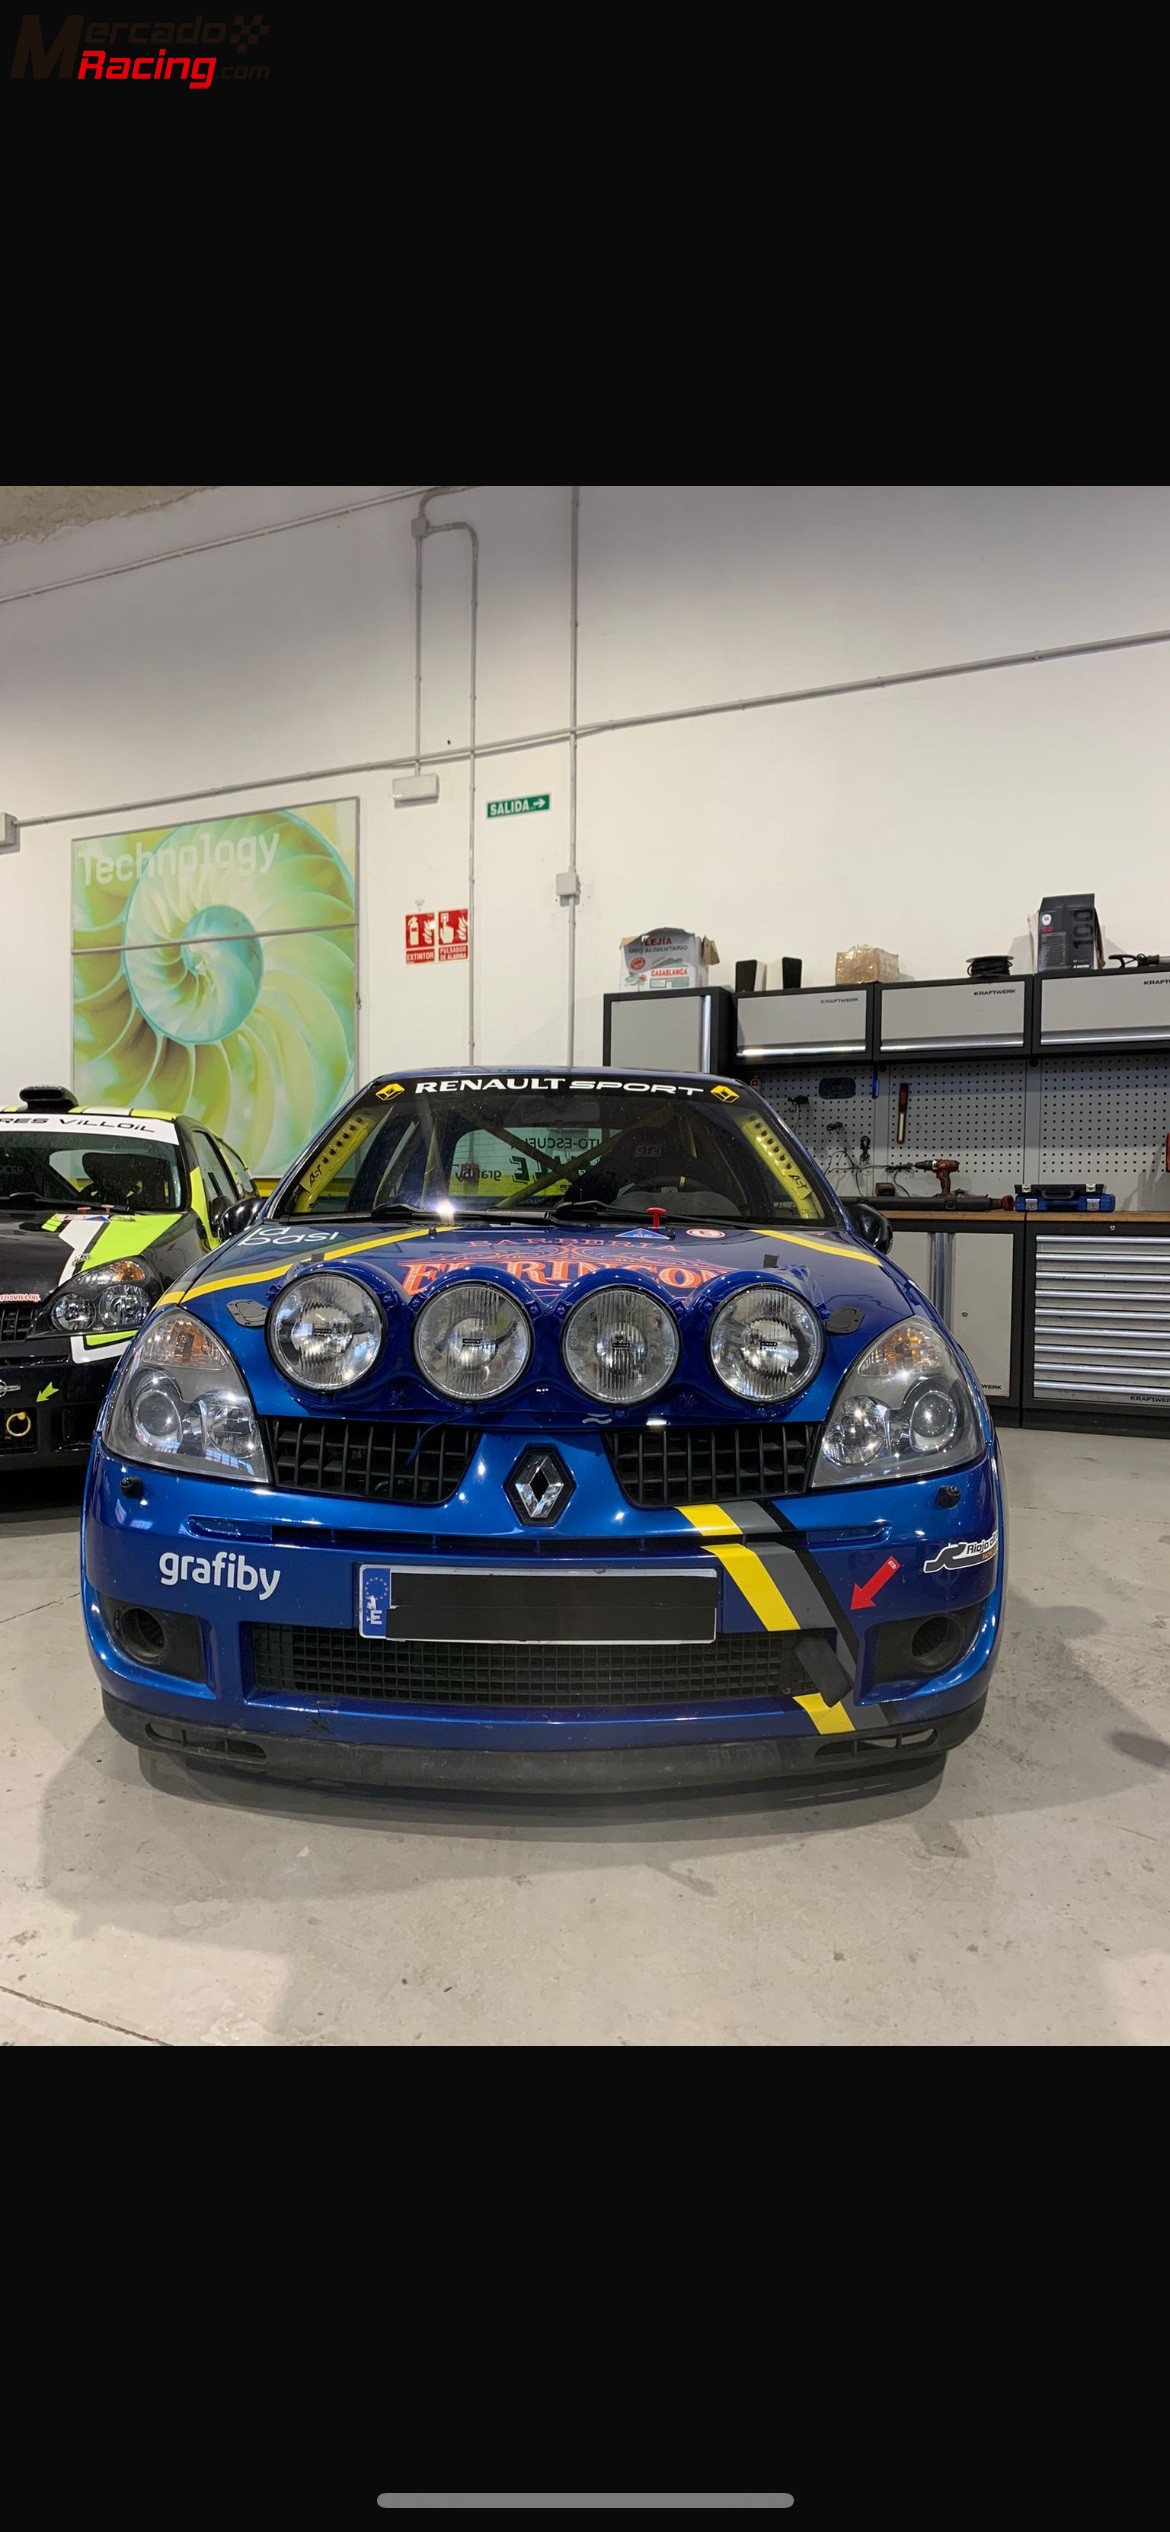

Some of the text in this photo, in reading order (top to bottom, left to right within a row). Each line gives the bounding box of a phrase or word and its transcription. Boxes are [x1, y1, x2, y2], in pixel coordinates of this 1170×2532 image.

[490, 799, 530, 816] SALIDA
[78, 832, 280, 886] Technology
[645, 945, 688, 953] ALIMENTARIO
[650, 967, 688, 977] CASABLANCA
[973, 988, 1016, 996] KRAFTWERK
[415, 1077, 704, 1096] RENAULT SPORT
[159, 1551, 281, 1601] grafiby
[370, 1609, 383, 1625] E
